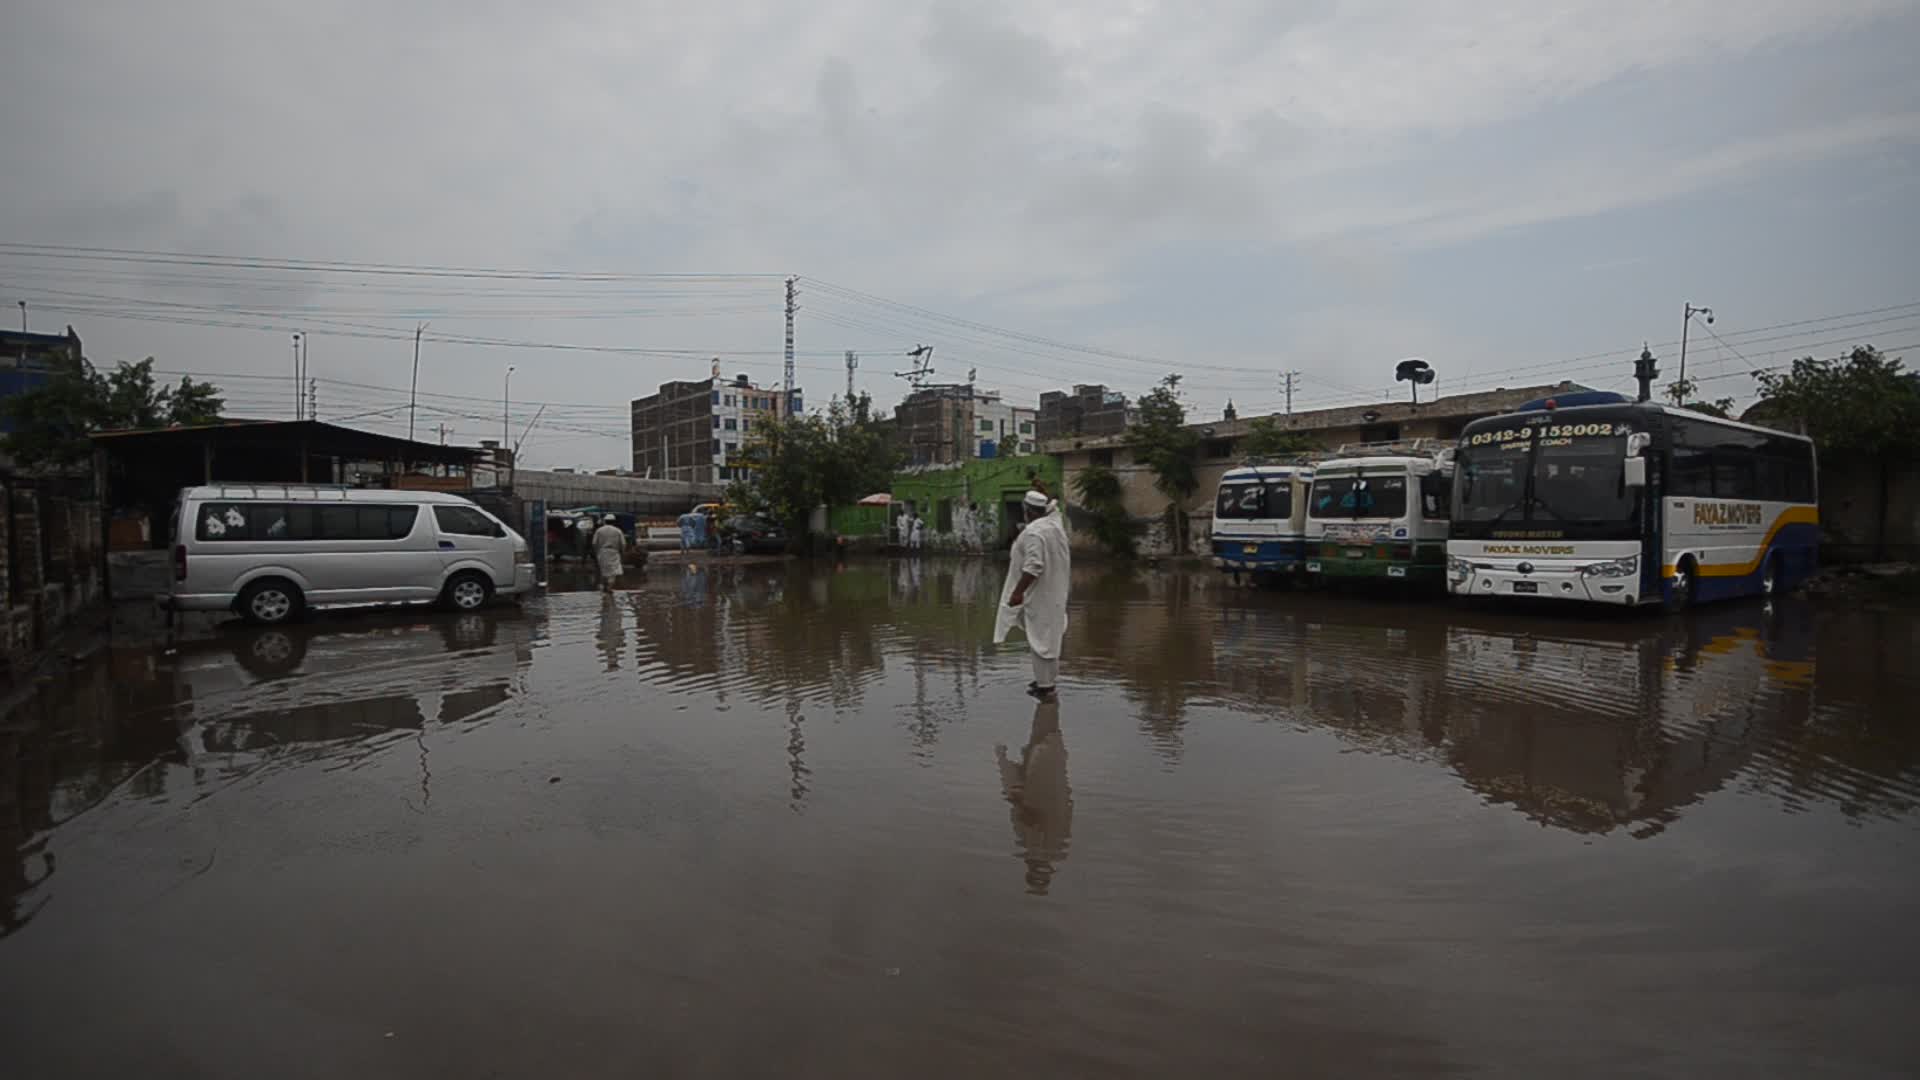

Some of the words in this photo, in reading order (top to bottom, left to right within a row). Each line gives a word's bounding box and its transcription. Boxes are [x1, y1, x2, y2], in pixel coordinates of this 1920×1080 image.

[1471, 427, 1532, 445] 0342-9
[1539, 423, 1613, 438] 152002
[1539, 437, 1573, 446] COACH
[1694, 503, 1727, 525] FAYAZ
[1727, 503, 1761, 525] MOVERS
[1483, 545, 1521, 554] FAYAZ
[1523, 545, 1575, 555] MOVERS
